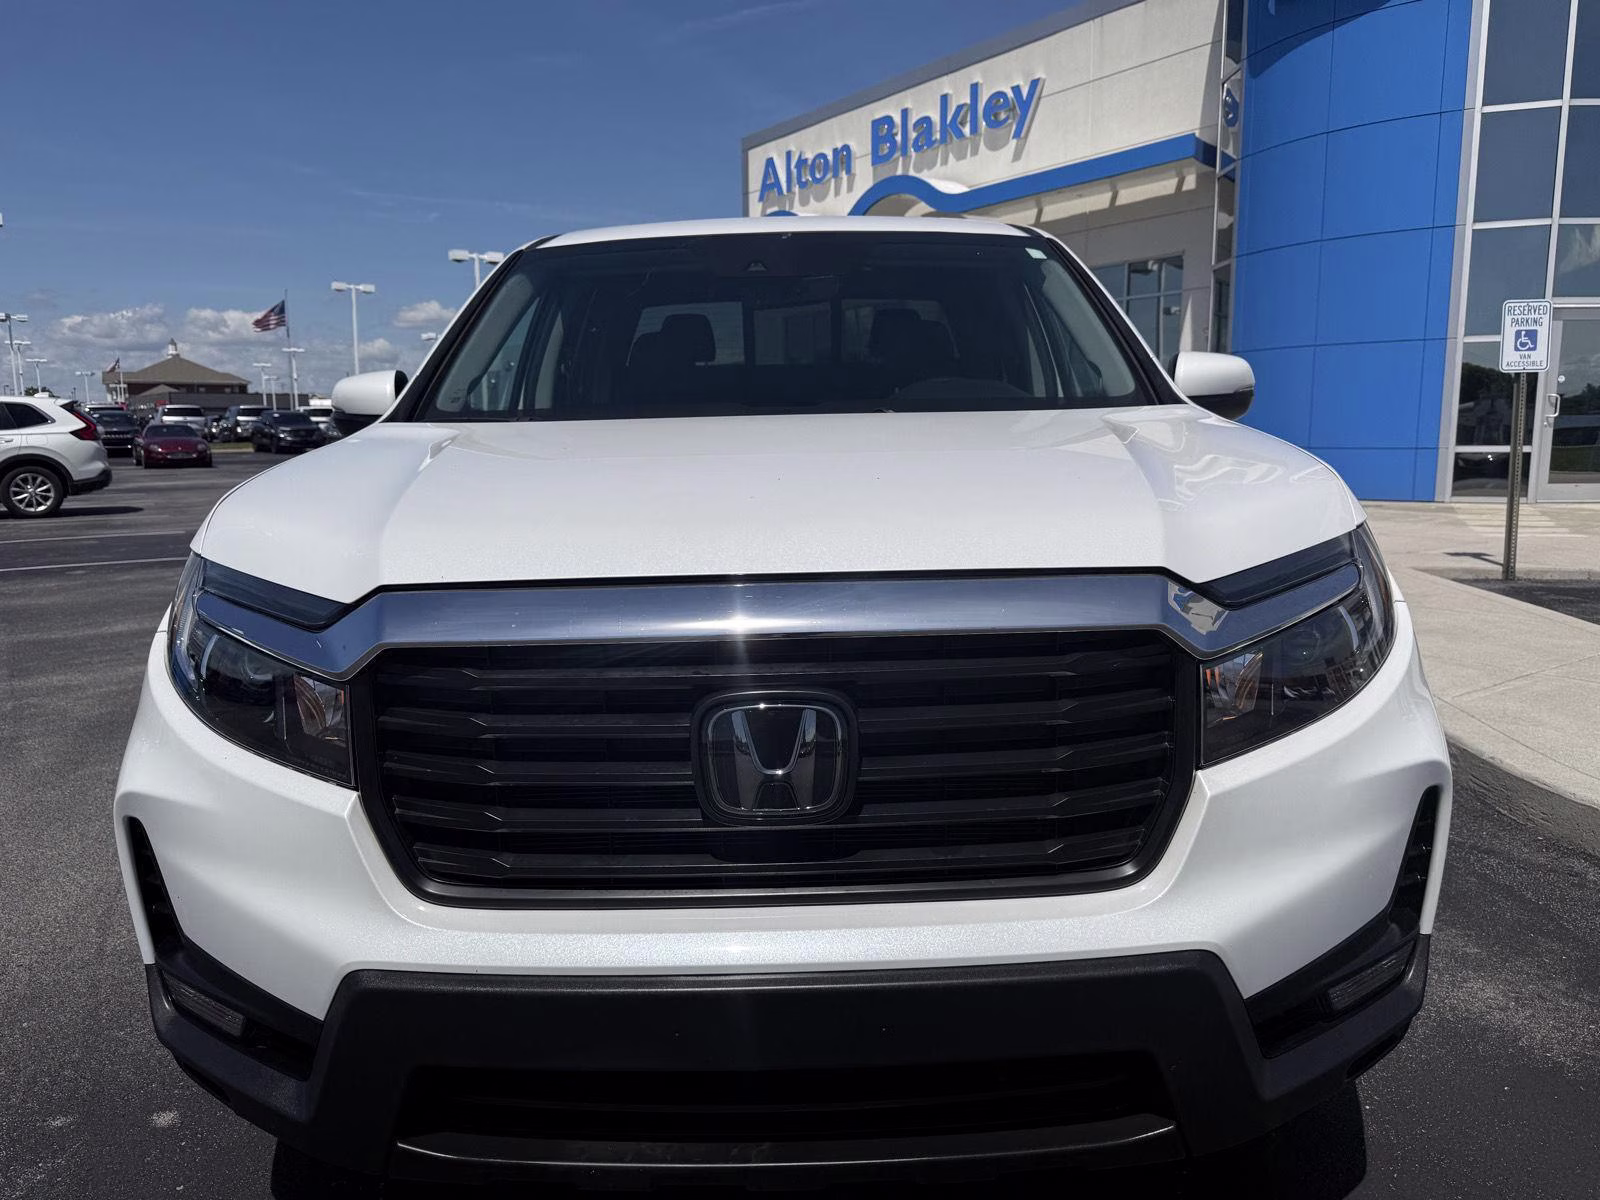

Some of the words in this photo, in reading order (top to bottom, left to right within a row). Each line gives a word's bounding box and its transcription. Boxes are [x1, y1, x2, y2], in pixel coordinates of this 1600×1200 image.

[758, 143, 852, 202] Alton
[871, 77, 1042, 167] Blakley
[1507, 304, 1548, 316] RESERVED
[1511, 317, 1543, 327] PARKING
[1506, 360, 1544, 368] ACCESSIBLE
